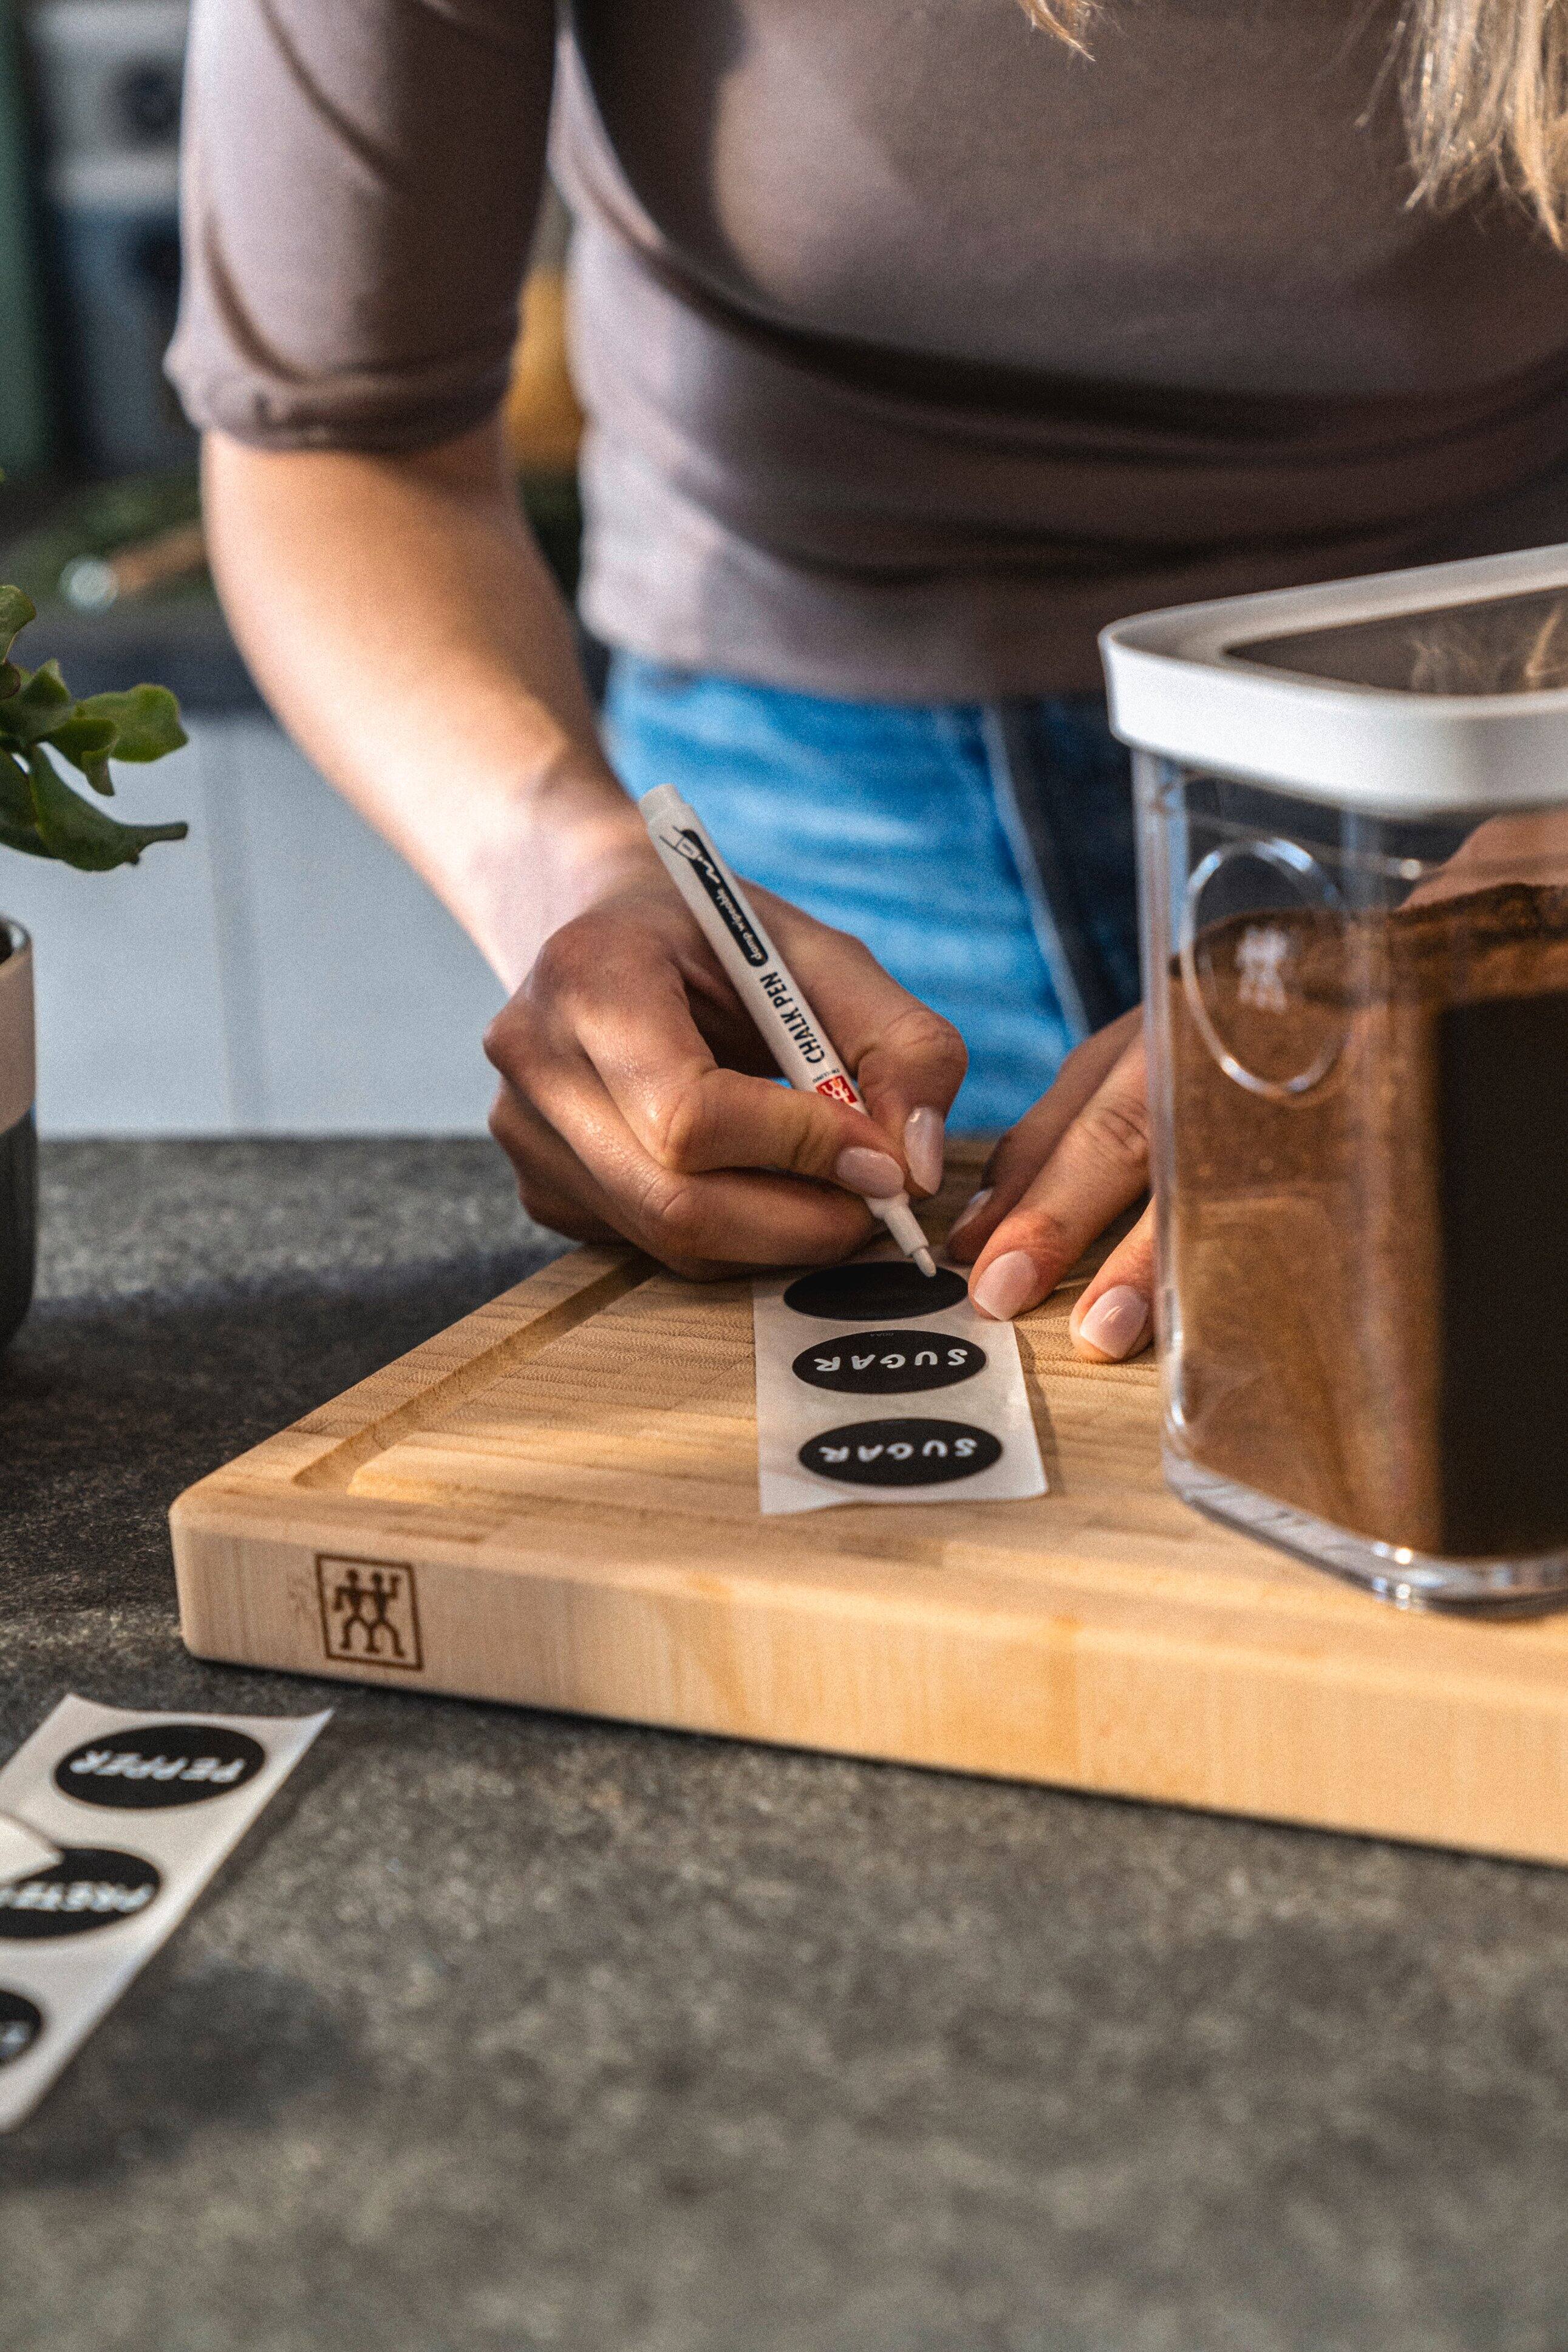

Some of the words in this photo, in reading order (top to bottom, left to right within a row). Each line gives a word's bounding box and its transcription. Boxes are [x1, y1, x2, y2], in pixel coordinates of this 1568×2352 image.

[742, 931, 765, 960] damp
[760, 972, 793, 1008] PEN
[780, 1007, 825, 1063] CHALK
[814, 1348, 968, 1372] SUGAR
[819, 1437, 977, 1463] SUGAR
[69, 1749, 243, 1782] PEPPER
